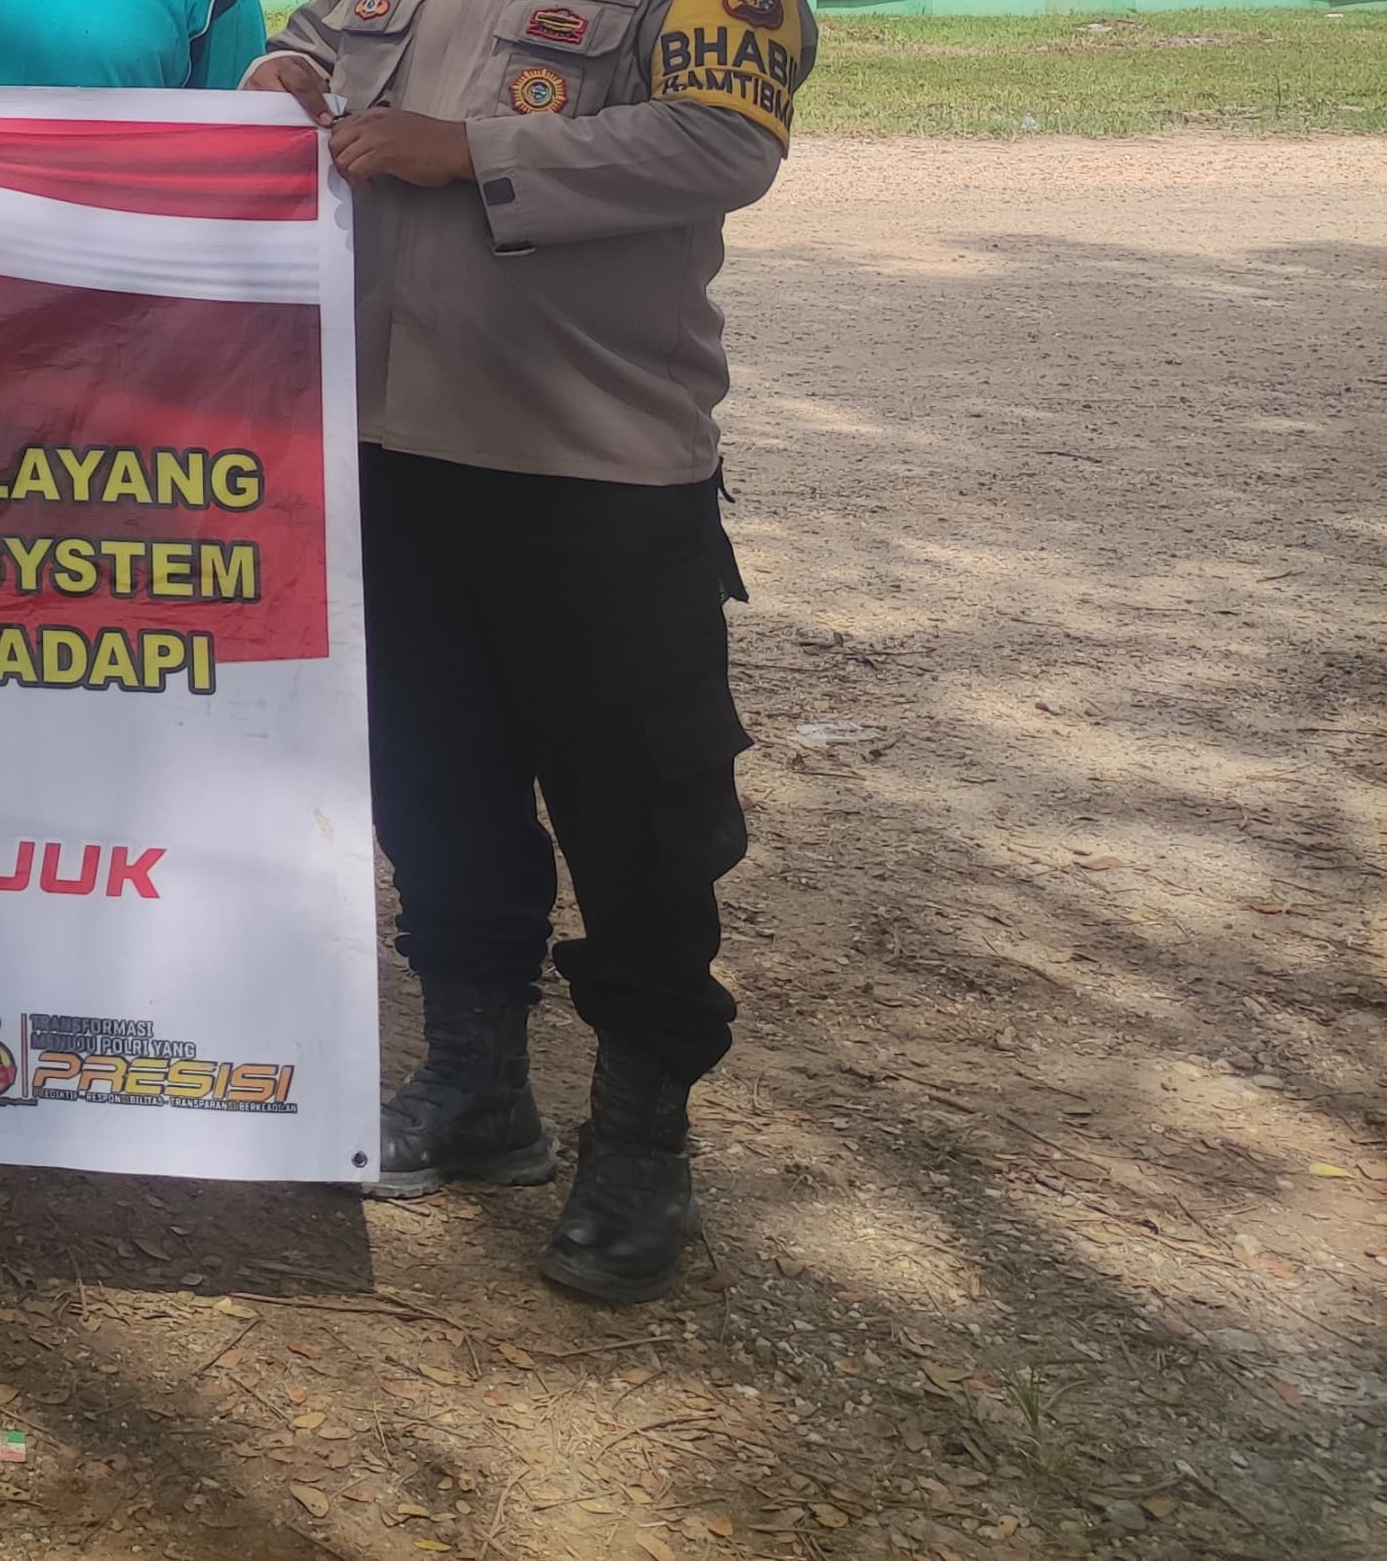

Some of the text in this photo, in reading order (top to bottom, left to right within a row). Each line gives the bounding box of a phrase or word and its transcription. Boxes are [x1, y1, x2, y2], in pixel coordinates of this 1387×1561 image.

[661, 26, 800, 96] BHABI
[29, 1014, 154, 1038] TRANSFORMASI
[31, 1033, 197, 1059] MENUJU POLRI YANG
[32, 1051, 295, 1103] PRESISI
